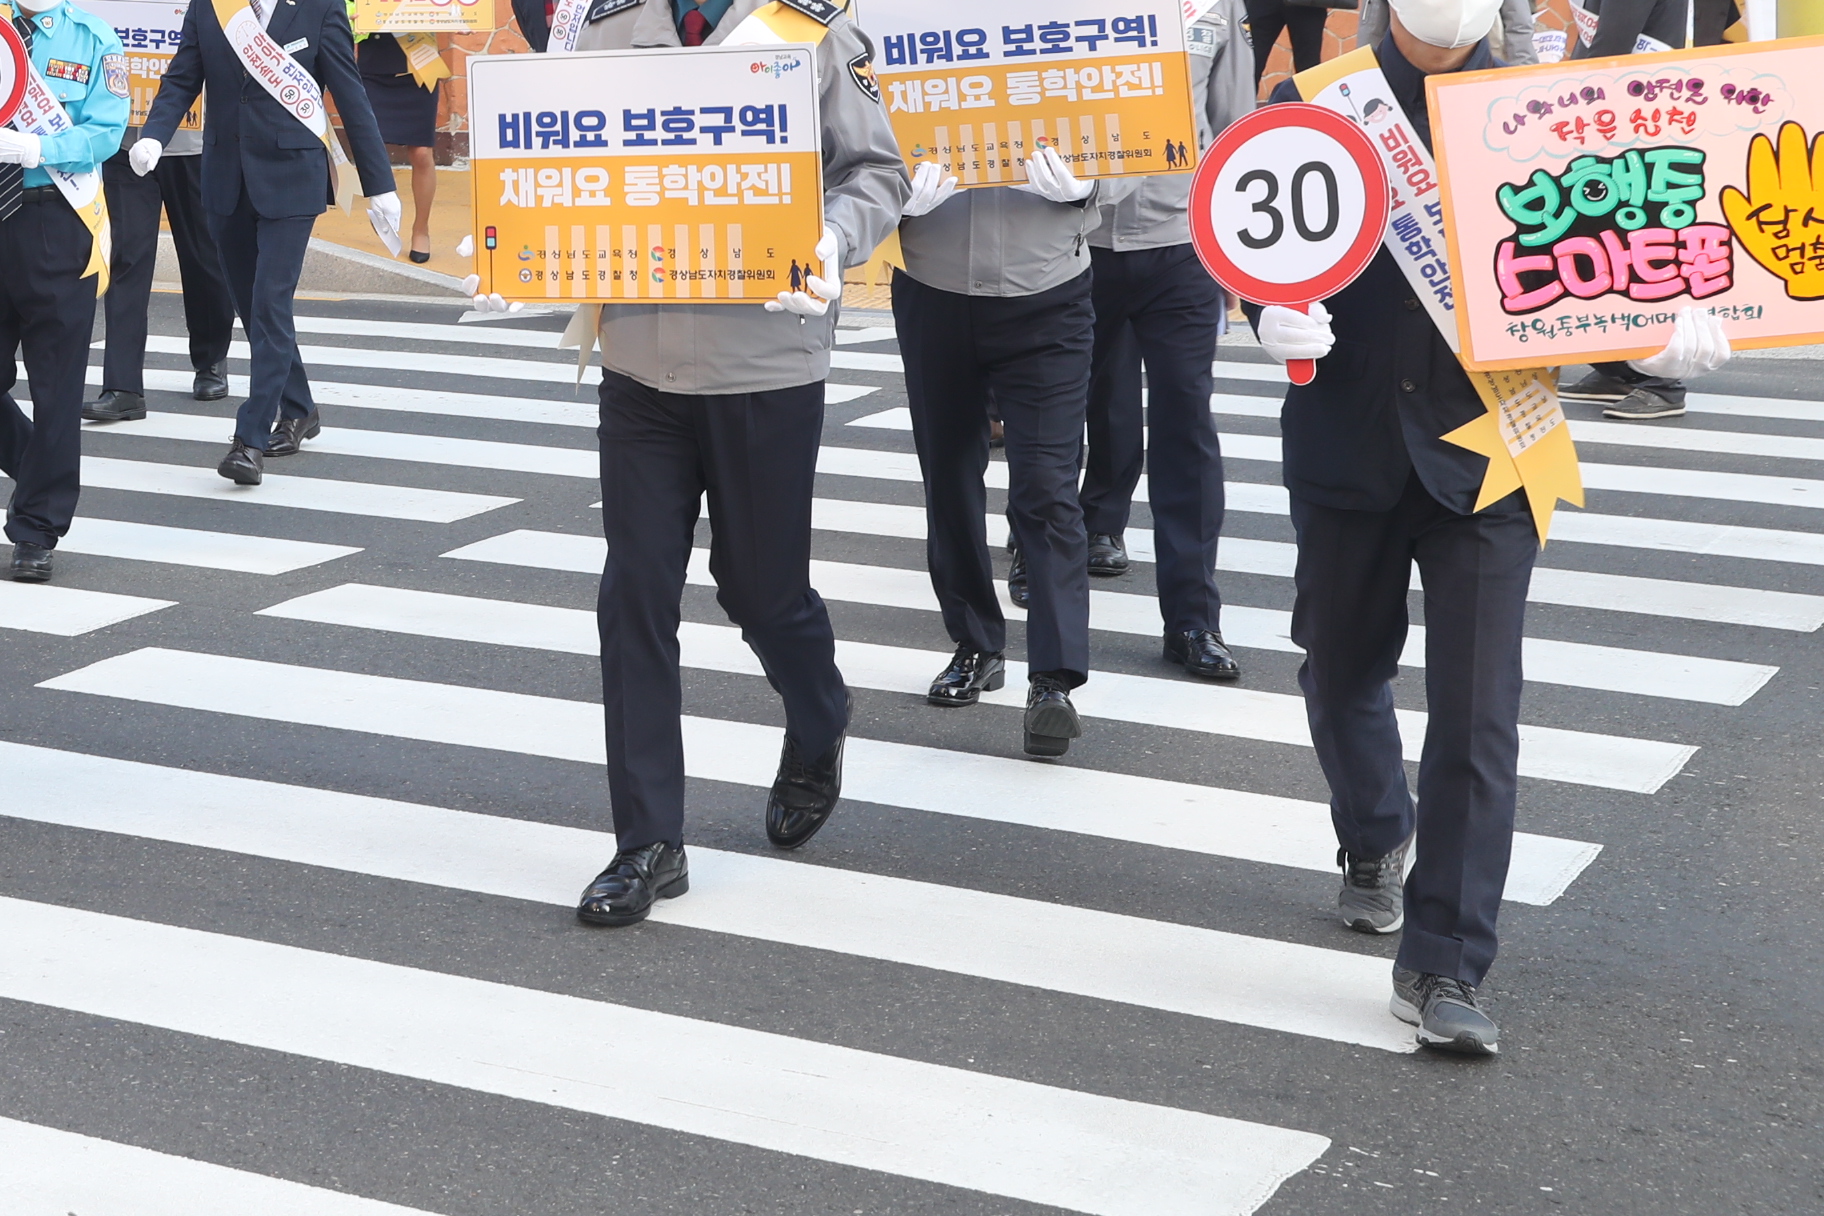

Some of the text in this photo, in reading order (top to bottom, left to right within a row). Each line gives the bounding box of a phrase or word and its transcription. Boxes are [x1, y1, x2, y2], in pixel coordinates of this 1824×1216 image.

[883, 14, 1159, 67] 비워요 보호구역!
[284, 89, 295, 100] 50
[300, 102, 311, 114] 30
[888, 61, 1164, 114] 채워요 통학안전!
[498, 103, 789, 150] 비워요 보호구역!
[1630, 106, 1697, 136] 실천
[1058, 148, 1153, 163] 상남도자치경찰위원회
[1379, 123, 1439, 198] 비워요
[499, 162, 793, 208] 채워요 통학안전!
[1234, 161, 1340, 250] 30
[1497, 147, 1706, 247] 보행중
[668, 269, 775, 282] 경상남도자치경찰위원회
[1495, 226, 1731, 312] 스마트폰
